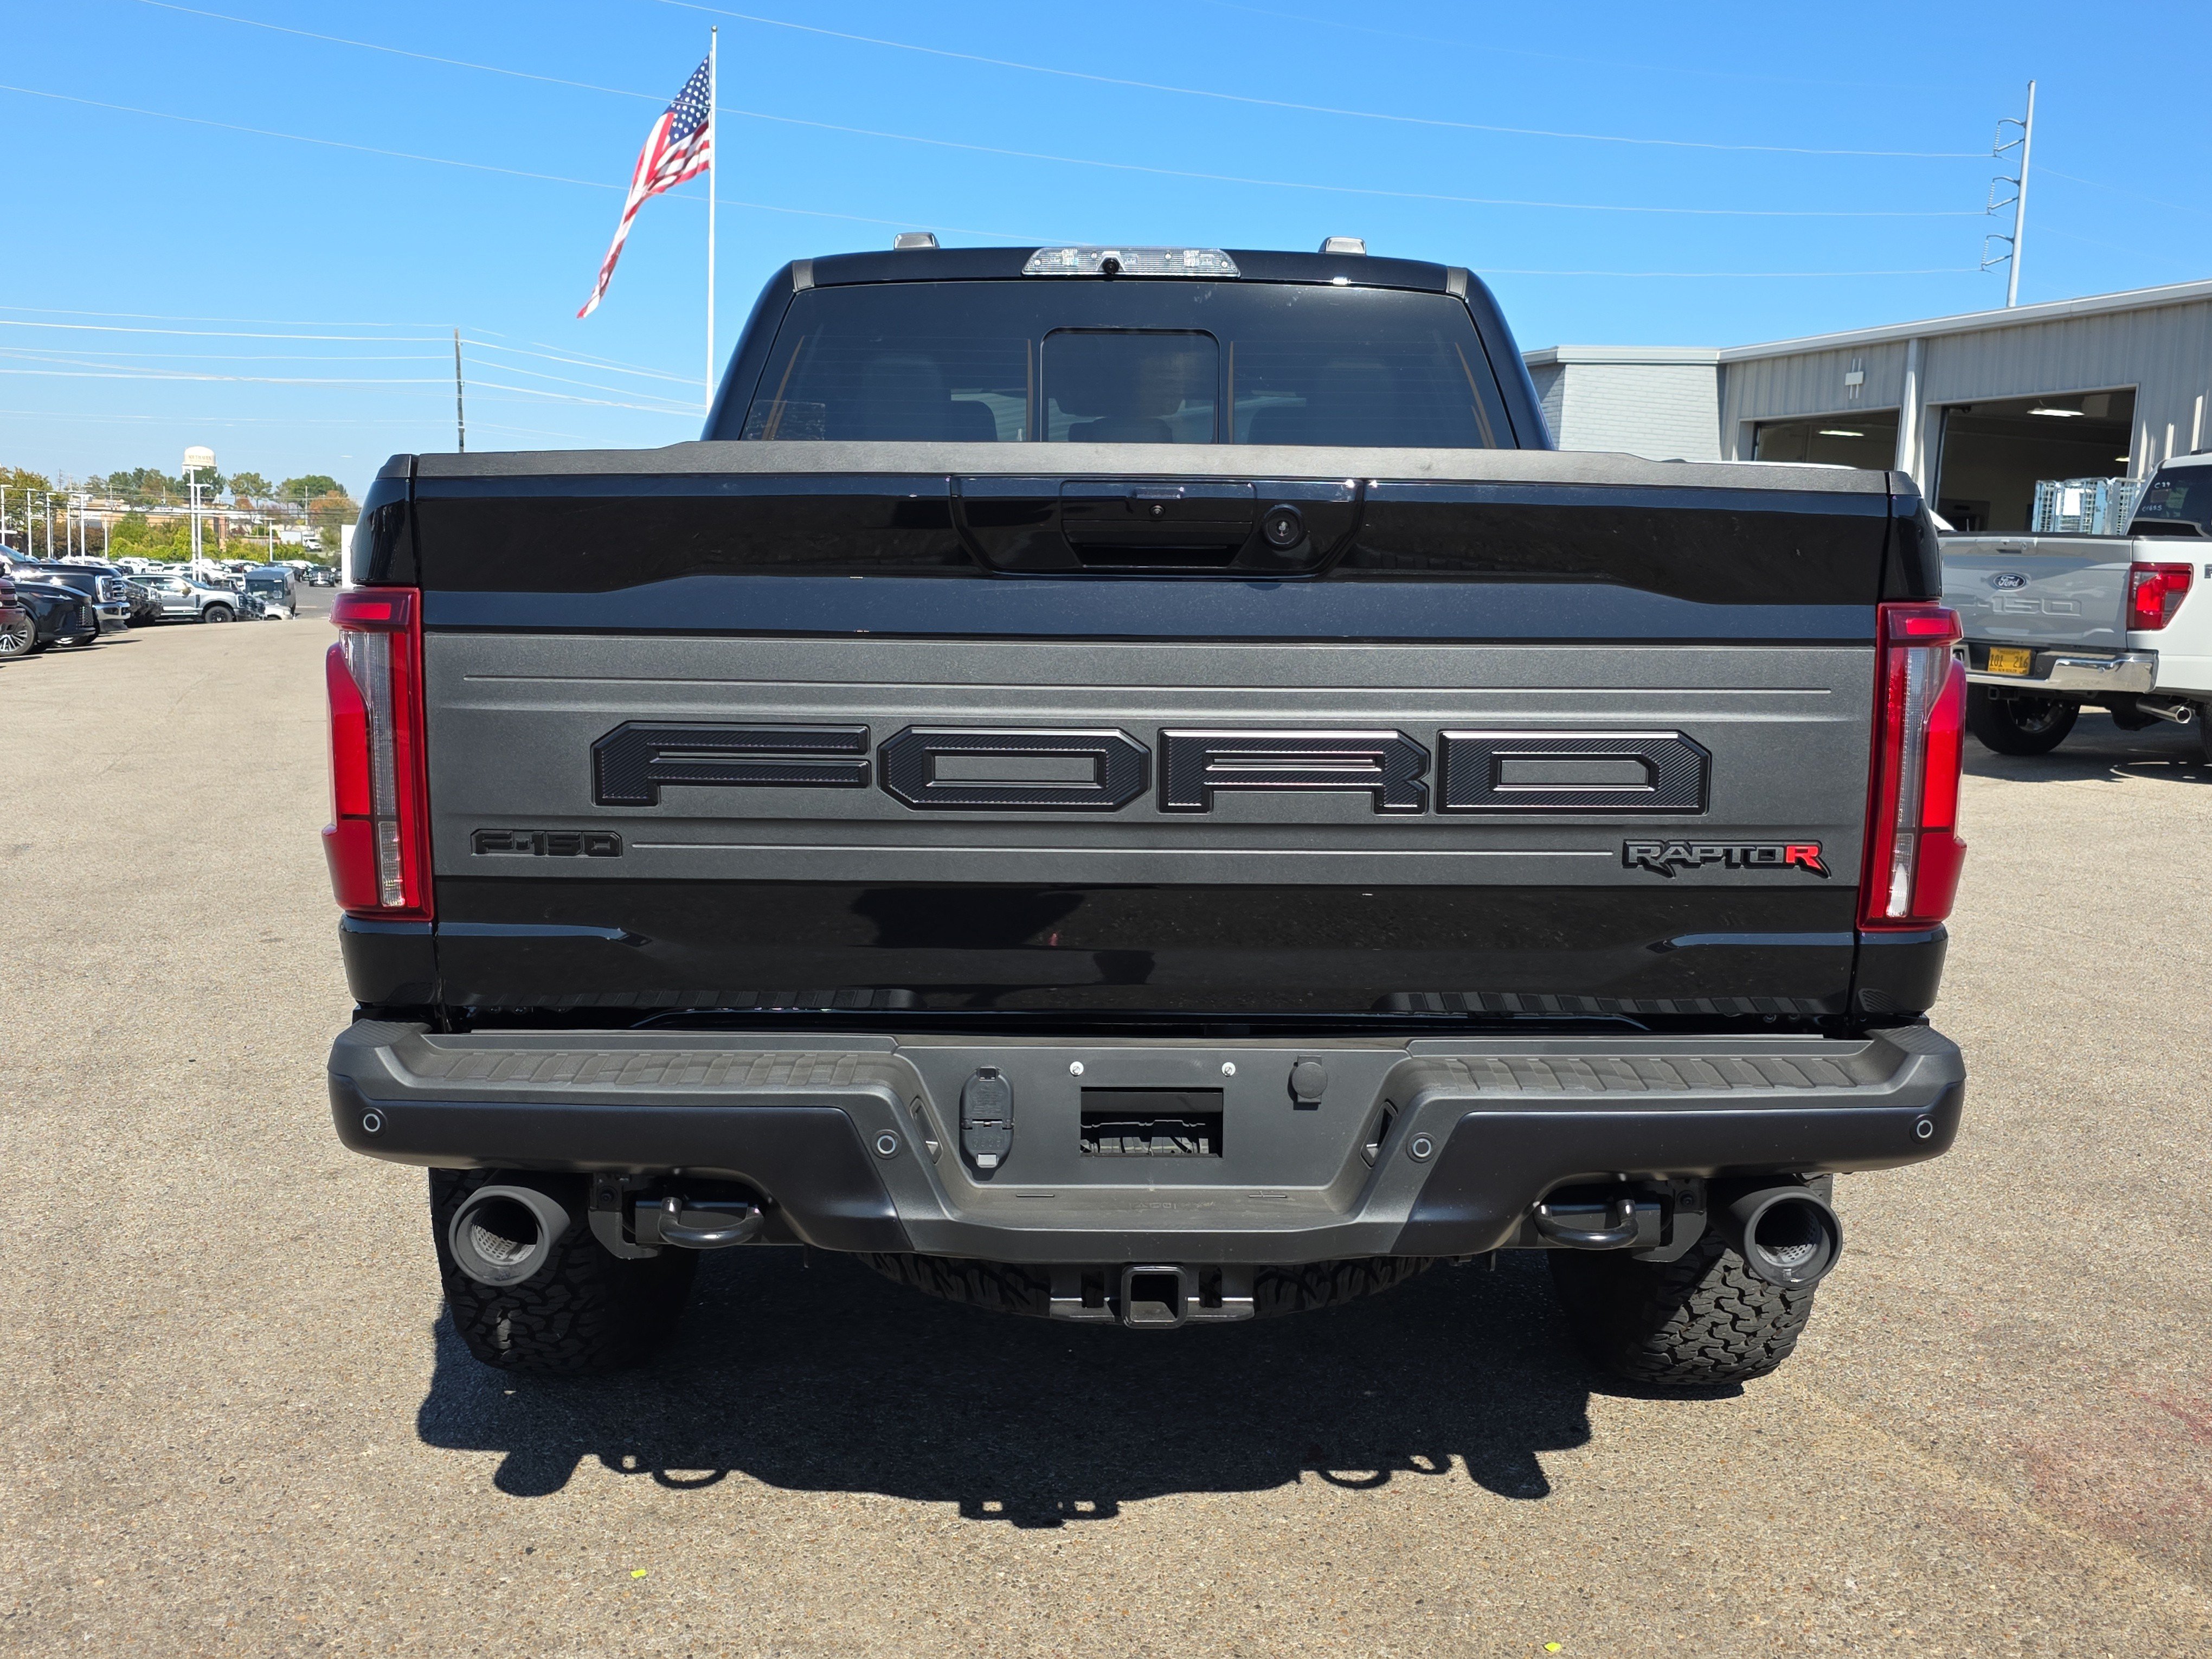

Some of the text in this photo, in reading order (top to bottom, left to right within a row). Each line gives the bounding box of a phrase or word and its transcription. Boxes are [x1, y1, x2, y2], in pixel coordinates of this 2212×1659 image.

[1997, 575, 2021, 587] Ford
[1990, 654, 2029, 668] 101 216
[590, 720, 1712, 815] FORD
[470, 828, 622, 858] F-150
[1622, 839, 1831, 879] RAPTOR
